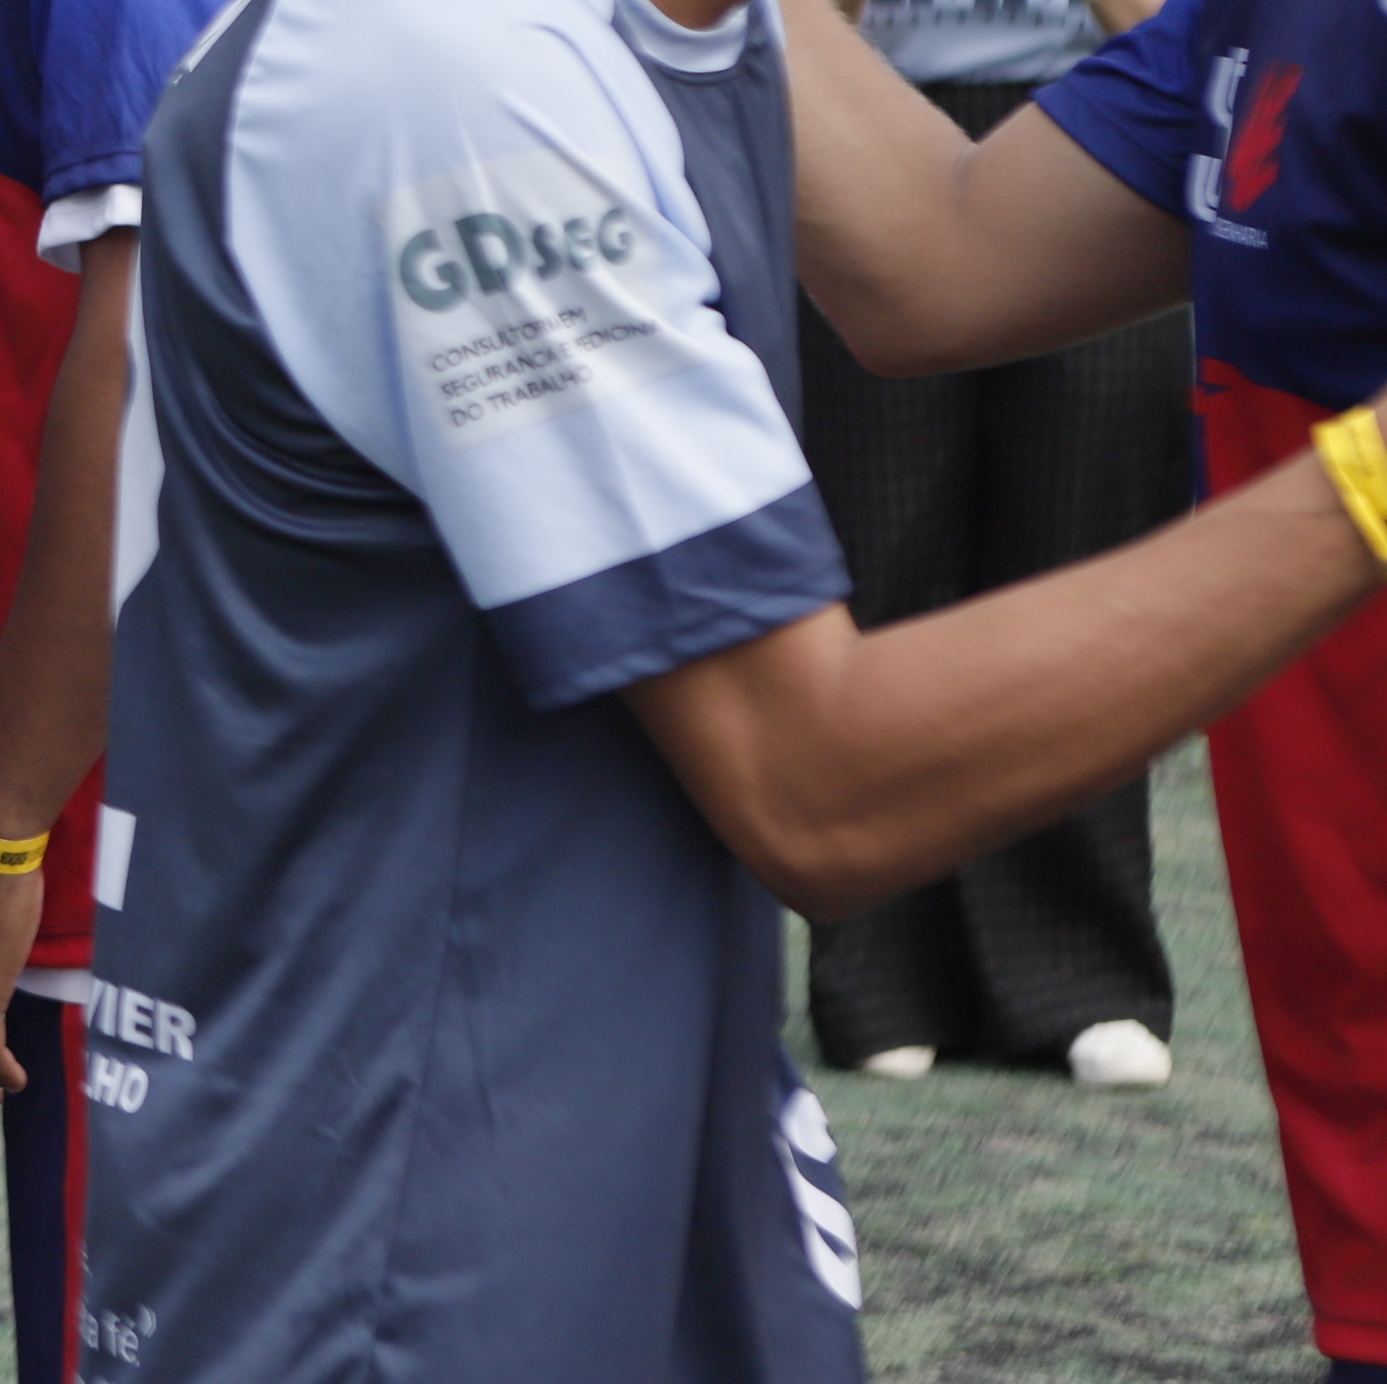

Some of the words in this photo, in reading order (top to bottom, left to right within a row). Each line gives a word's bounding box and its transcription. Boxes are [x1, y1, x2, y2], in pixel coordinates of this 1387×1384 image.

[399, 207, 634, 313] GDSEG
[448, 403, 484, 428] DO
[487, 365, 594, 412] TRABALHO
[82, 1050, 149, 1114] HO
